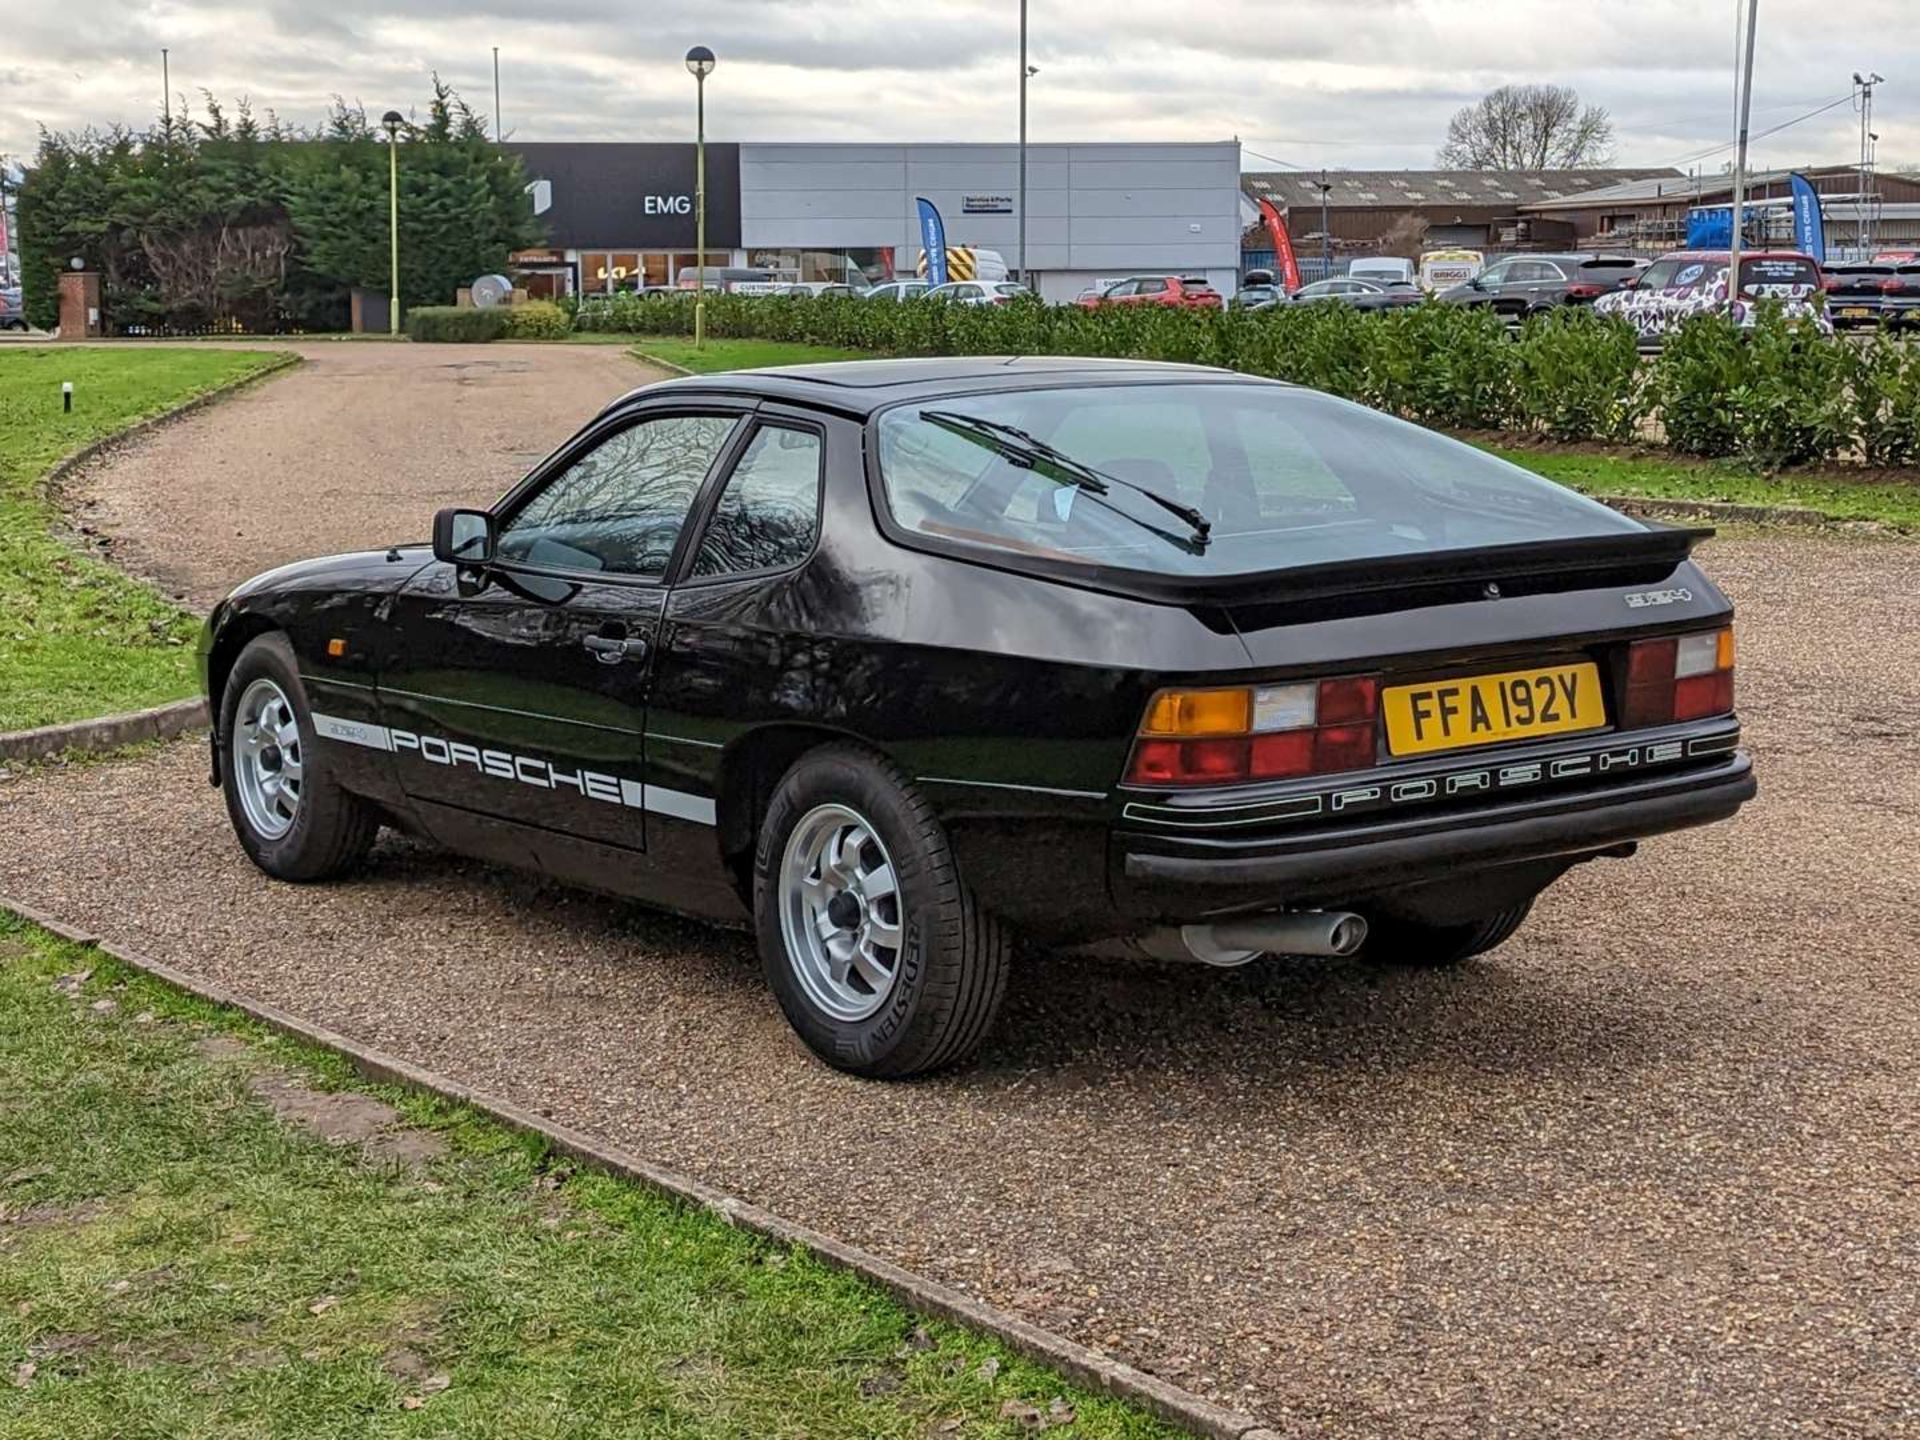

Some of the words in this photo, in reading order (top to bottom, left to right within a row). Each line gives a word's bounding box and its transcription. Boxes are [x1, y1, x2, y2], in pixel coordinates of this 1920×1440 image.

[644, 195, 691, 215] EMG
[390, 728, 625, 805] PORSCHE
[1331, 739, 1685, 811] PORSCHE
